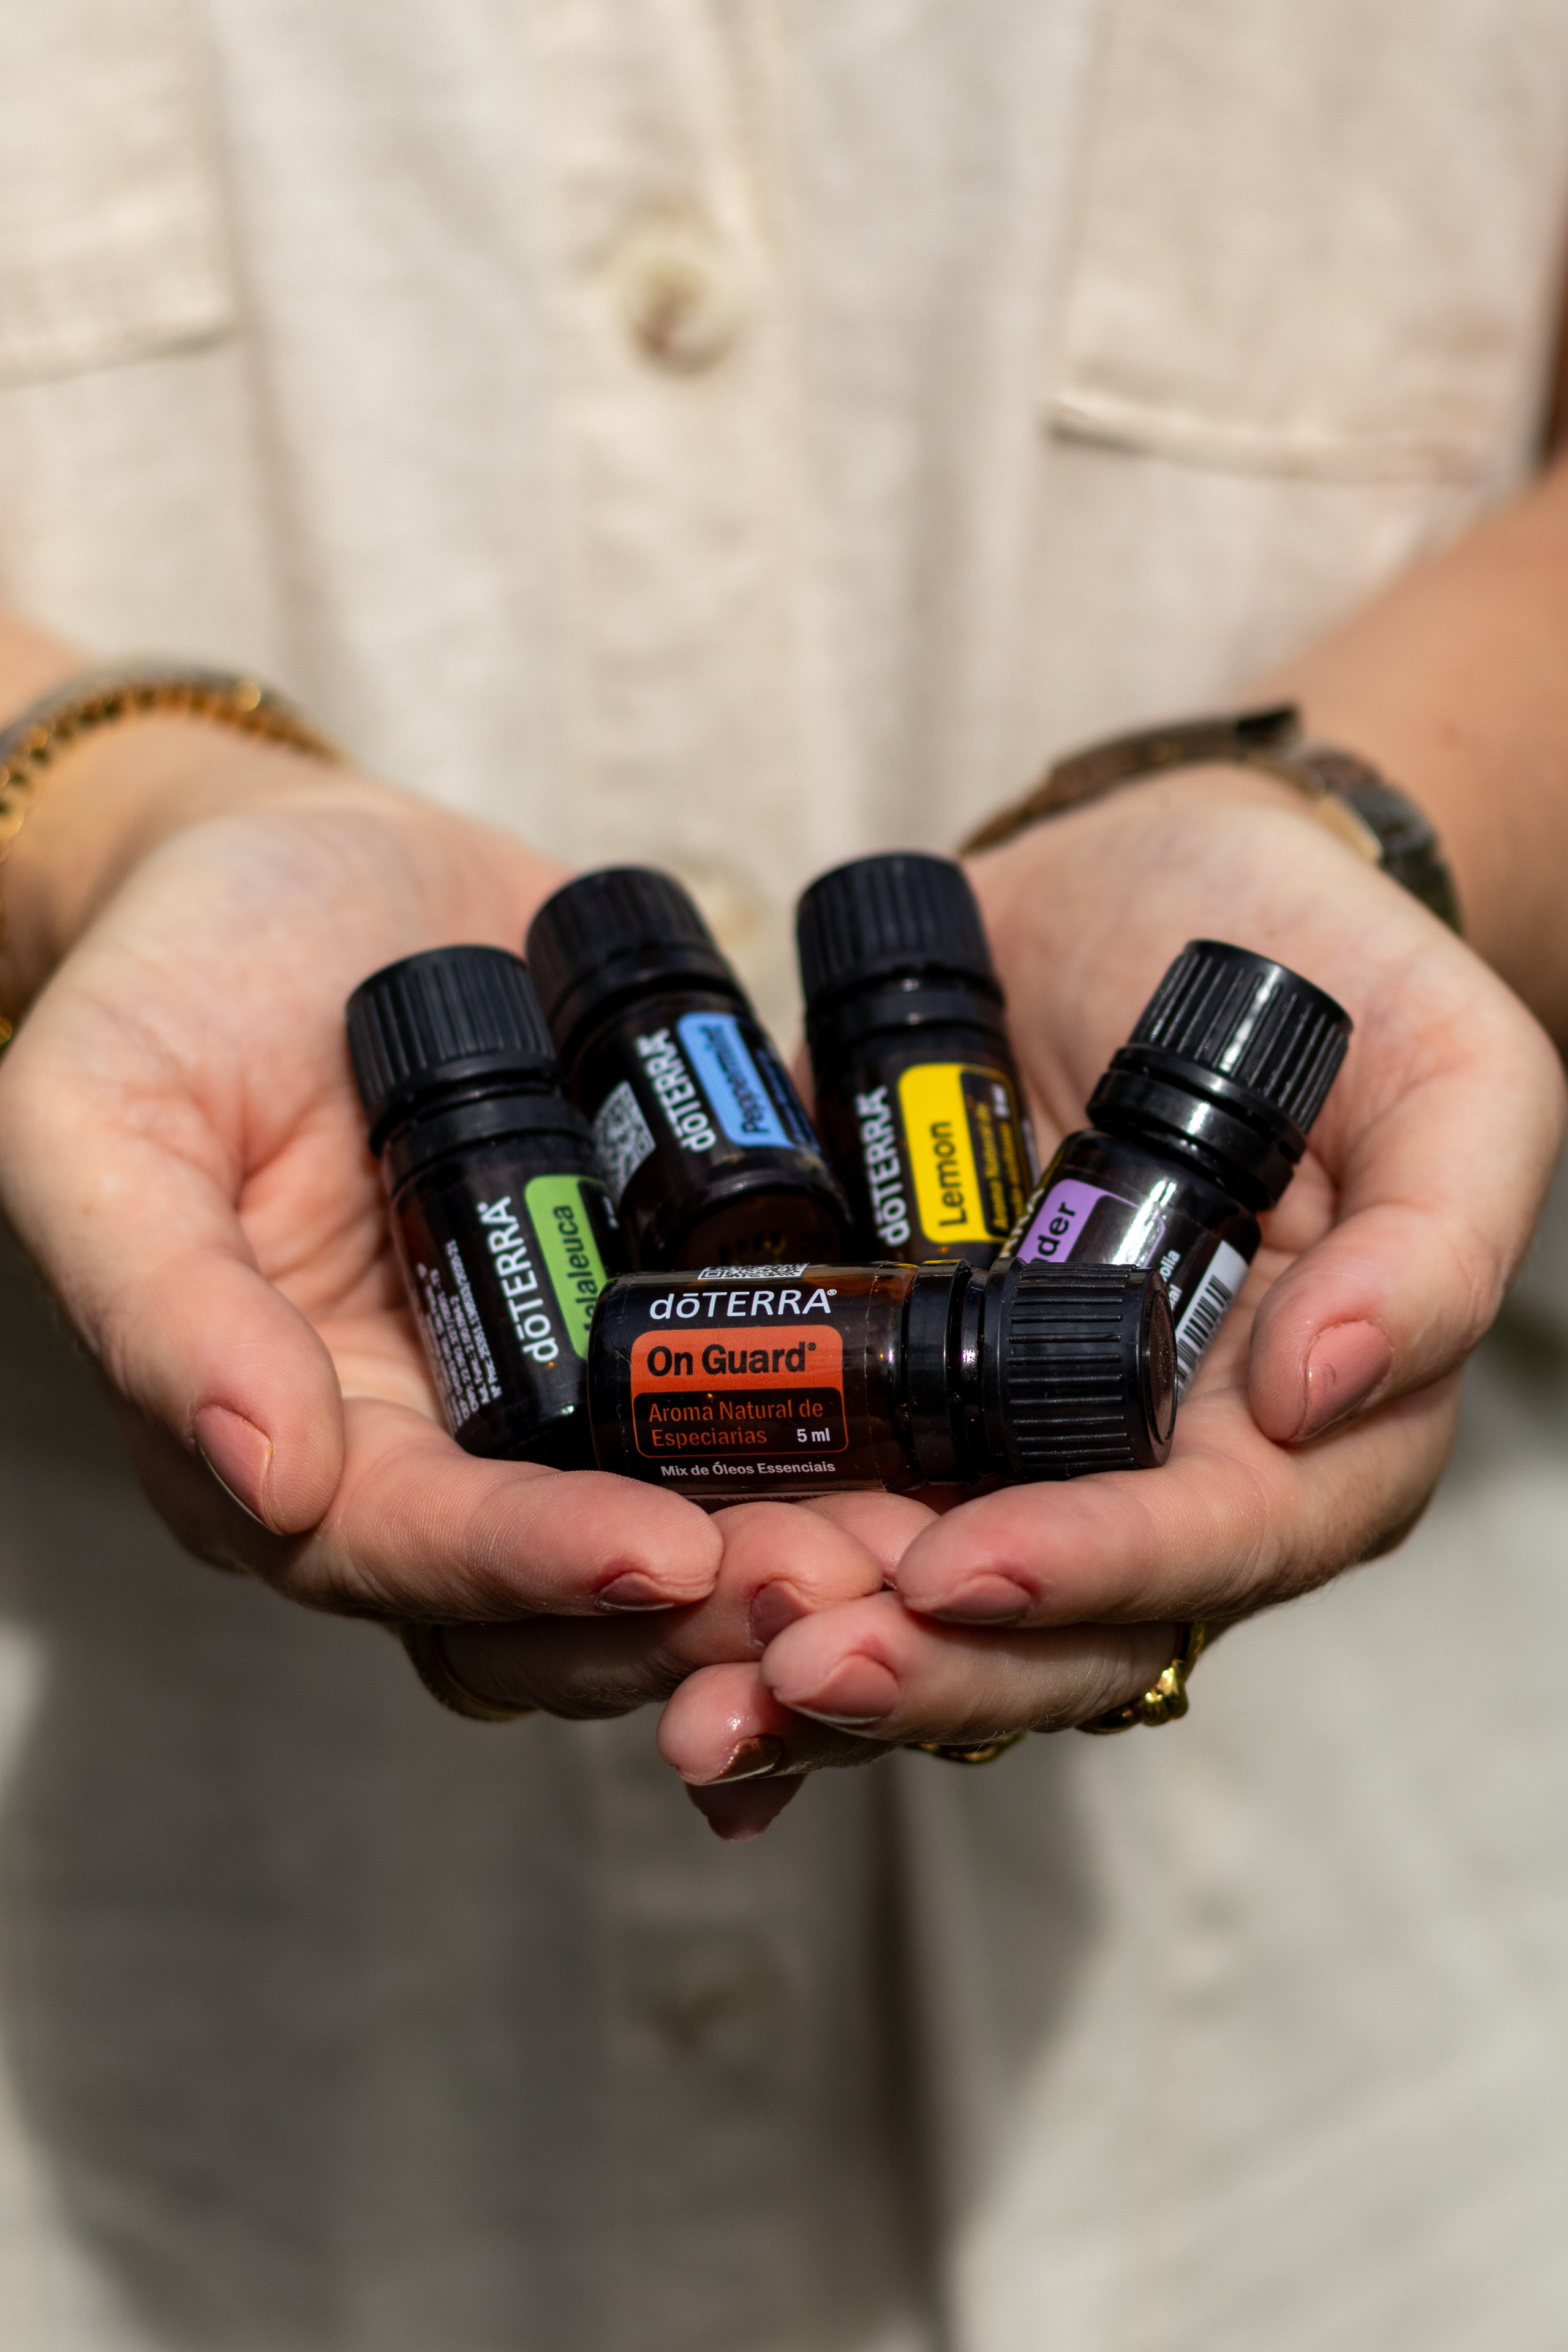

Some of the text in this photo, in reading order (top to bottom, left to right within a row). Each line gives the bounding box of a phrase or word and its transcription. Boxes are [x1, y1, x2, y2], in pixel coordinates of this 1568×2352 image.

[930, 1121, 967, 1227] Lemon
[553, 1205, 598, 1332] laleuca
[1159, 1250, 1180, 1283] olia
[647, 1346, 693, 1376] On
[649, 1399, 823, 1422] Aroma Natural de
[652, 1428, 767, 1449] Especiarias
[797, 1428, 830, 1442] 5 ml
[661, 1461, 835, 1476] Mix de Óleos Essenciais
